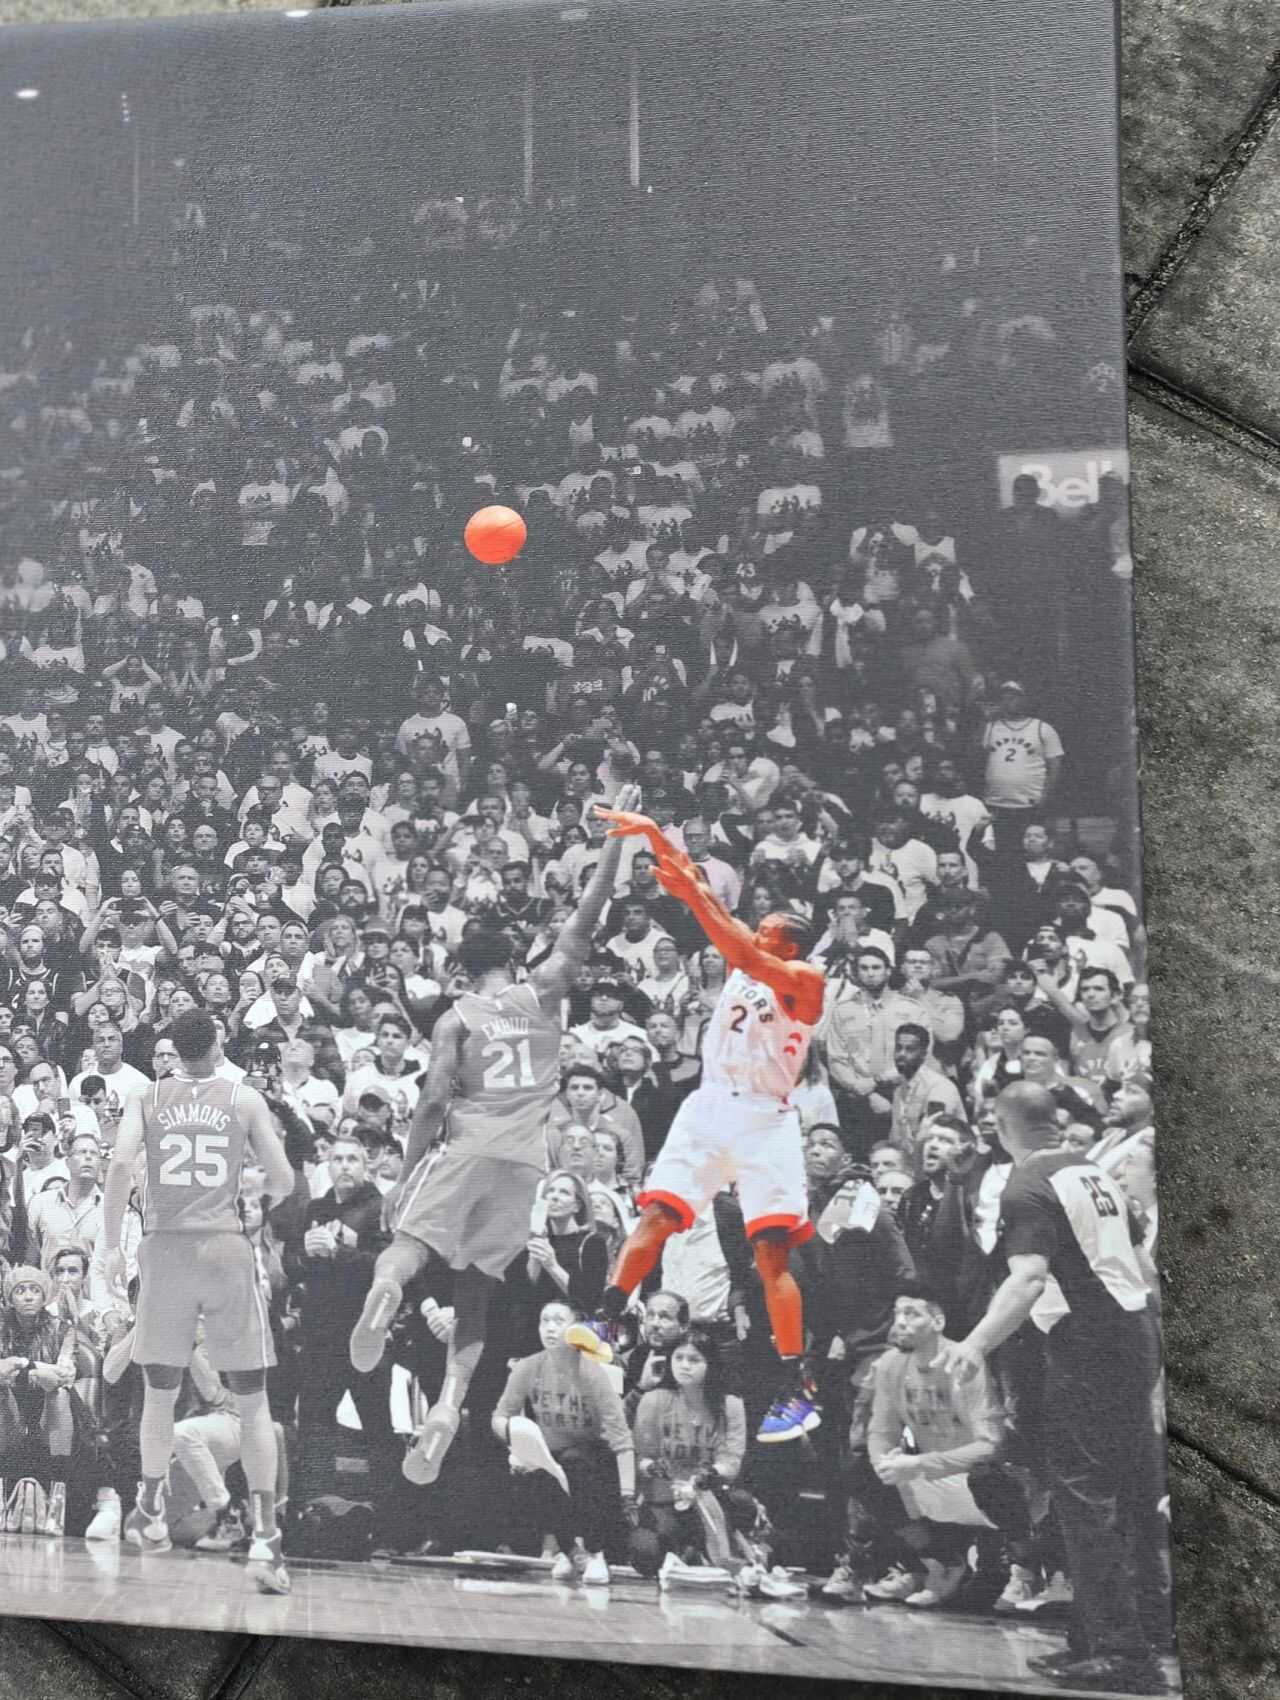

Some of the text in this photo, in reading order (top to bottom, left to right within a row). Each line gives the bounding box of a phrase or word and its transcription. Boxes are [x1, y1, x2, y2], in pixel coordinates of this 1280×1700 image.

[1020, 460, 1112, 507] Bel
[1004, 748, 1017, 762] 2
[730, 1004, 749, 1034] 2
[481, 1038, 537, 1089] 21
[157, 1103, 231, 1132] SIMMONS
[159, 1133, 229, 1188] 25
